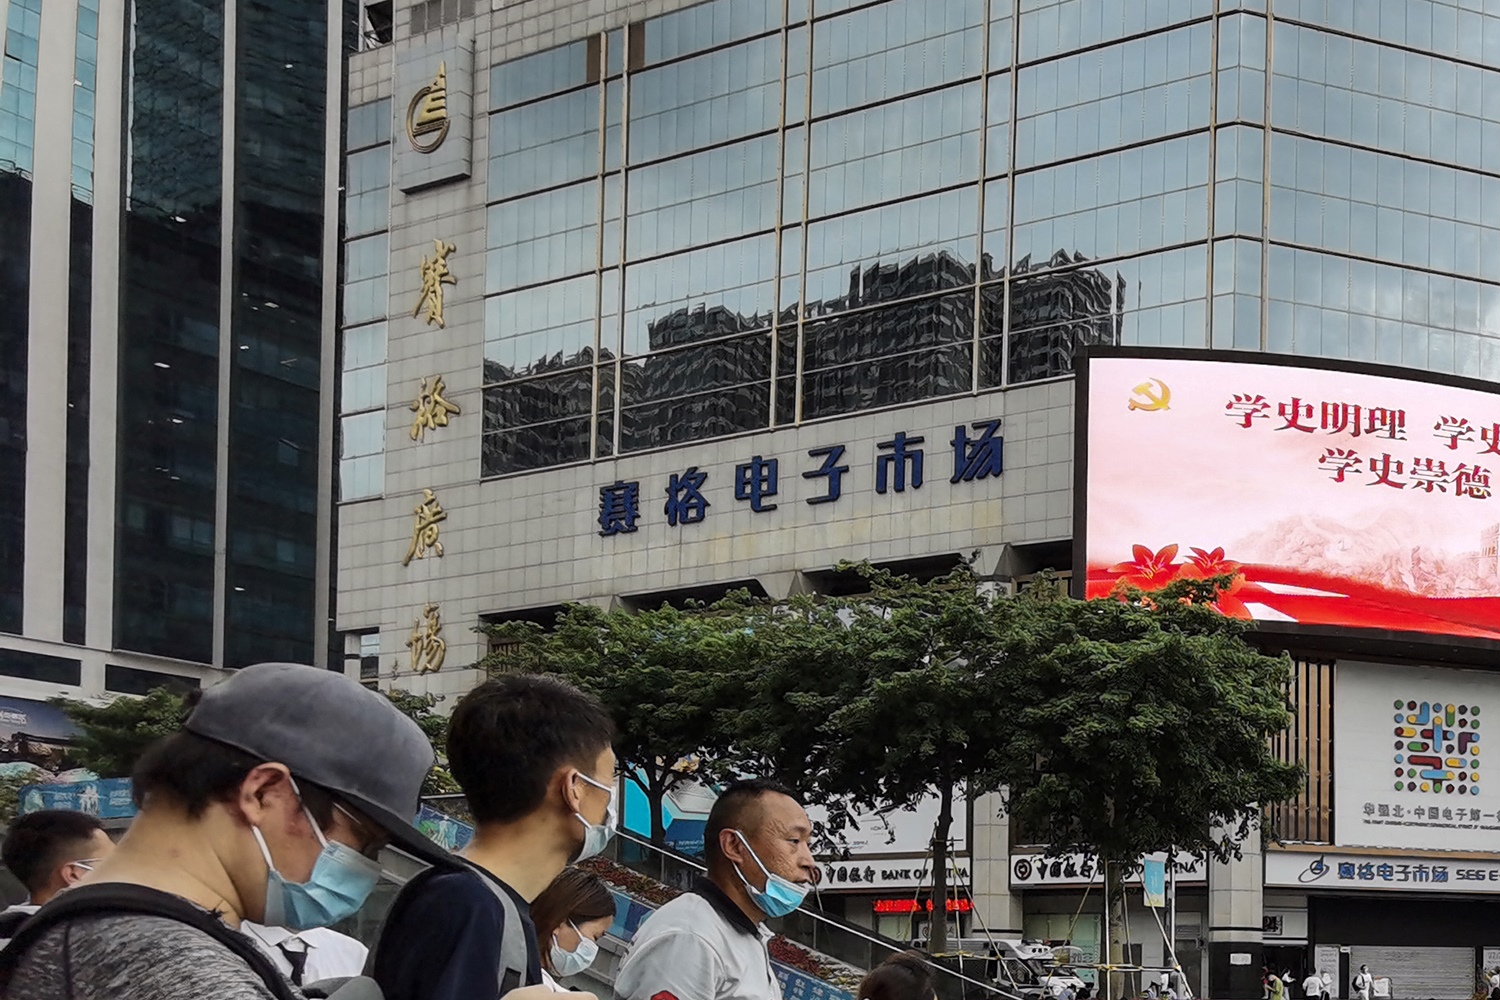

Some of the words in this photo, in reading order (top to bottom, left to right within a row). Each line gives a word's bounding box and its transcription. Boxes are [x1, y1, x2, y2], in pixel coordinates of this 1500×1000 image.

[1225, 392, 1407, 441] 学史明理
[598, 419, 1004, 537] 赛格电子市场
[1318, 447, 1492, 500] 学史崇德
[881, 869, 912, 880] BANK
[1337, 861, 1449, 883] 赛格电子市场
